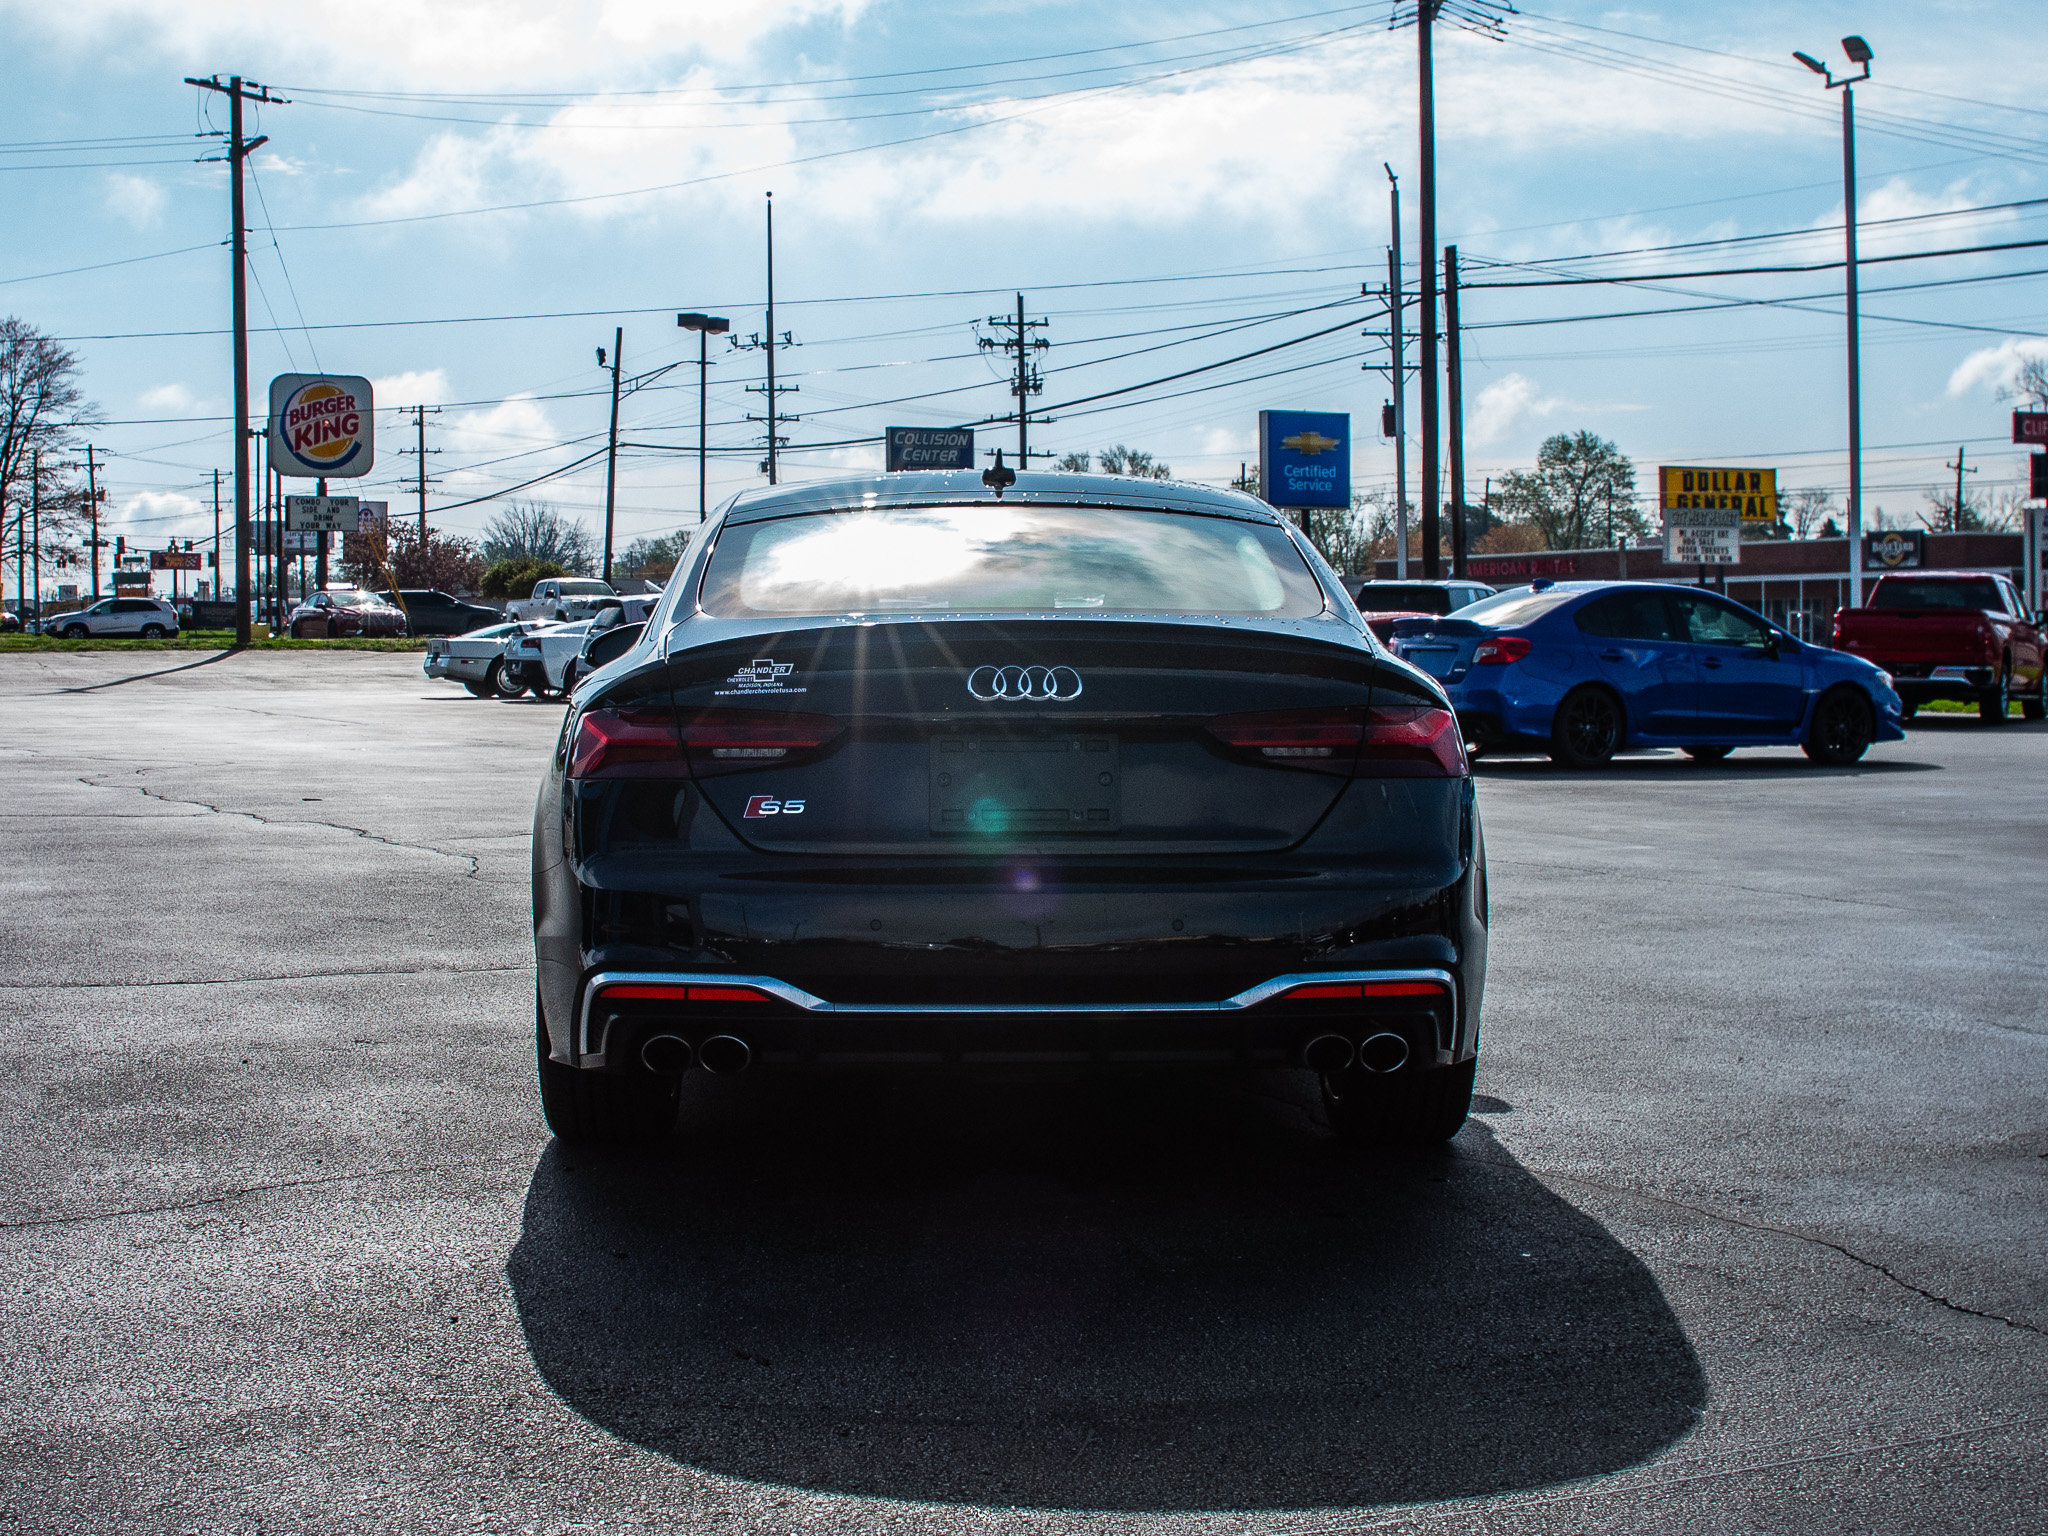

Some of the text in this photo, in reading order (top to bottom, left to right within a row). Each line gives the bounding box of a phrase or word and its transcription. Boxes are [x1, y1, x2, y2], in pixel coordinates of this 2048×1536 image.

[289, 395, 356, 428] BURGER
[294, 413, 360, 452] KING
[894, 431, 969, 446] COLLISION
[902, 447, 959, 462] CENTER
[1284, 464, 1337, 478] Certified
[1288, 478, 1333, 491] Service
[1682, 470, 1762, 494] DOLLAR
[295, 498, 350, 507] COMBO YOUR
[1691, 529, 1715, 538] ACCEPT
[1467, 561, 1528, 577] AMERICAN
[738, 666, 786, 675] CHANDLER
[714, 687, 807, 696] www.chandlerchevroletusa.com
[758, 799, 806, 815] S5
